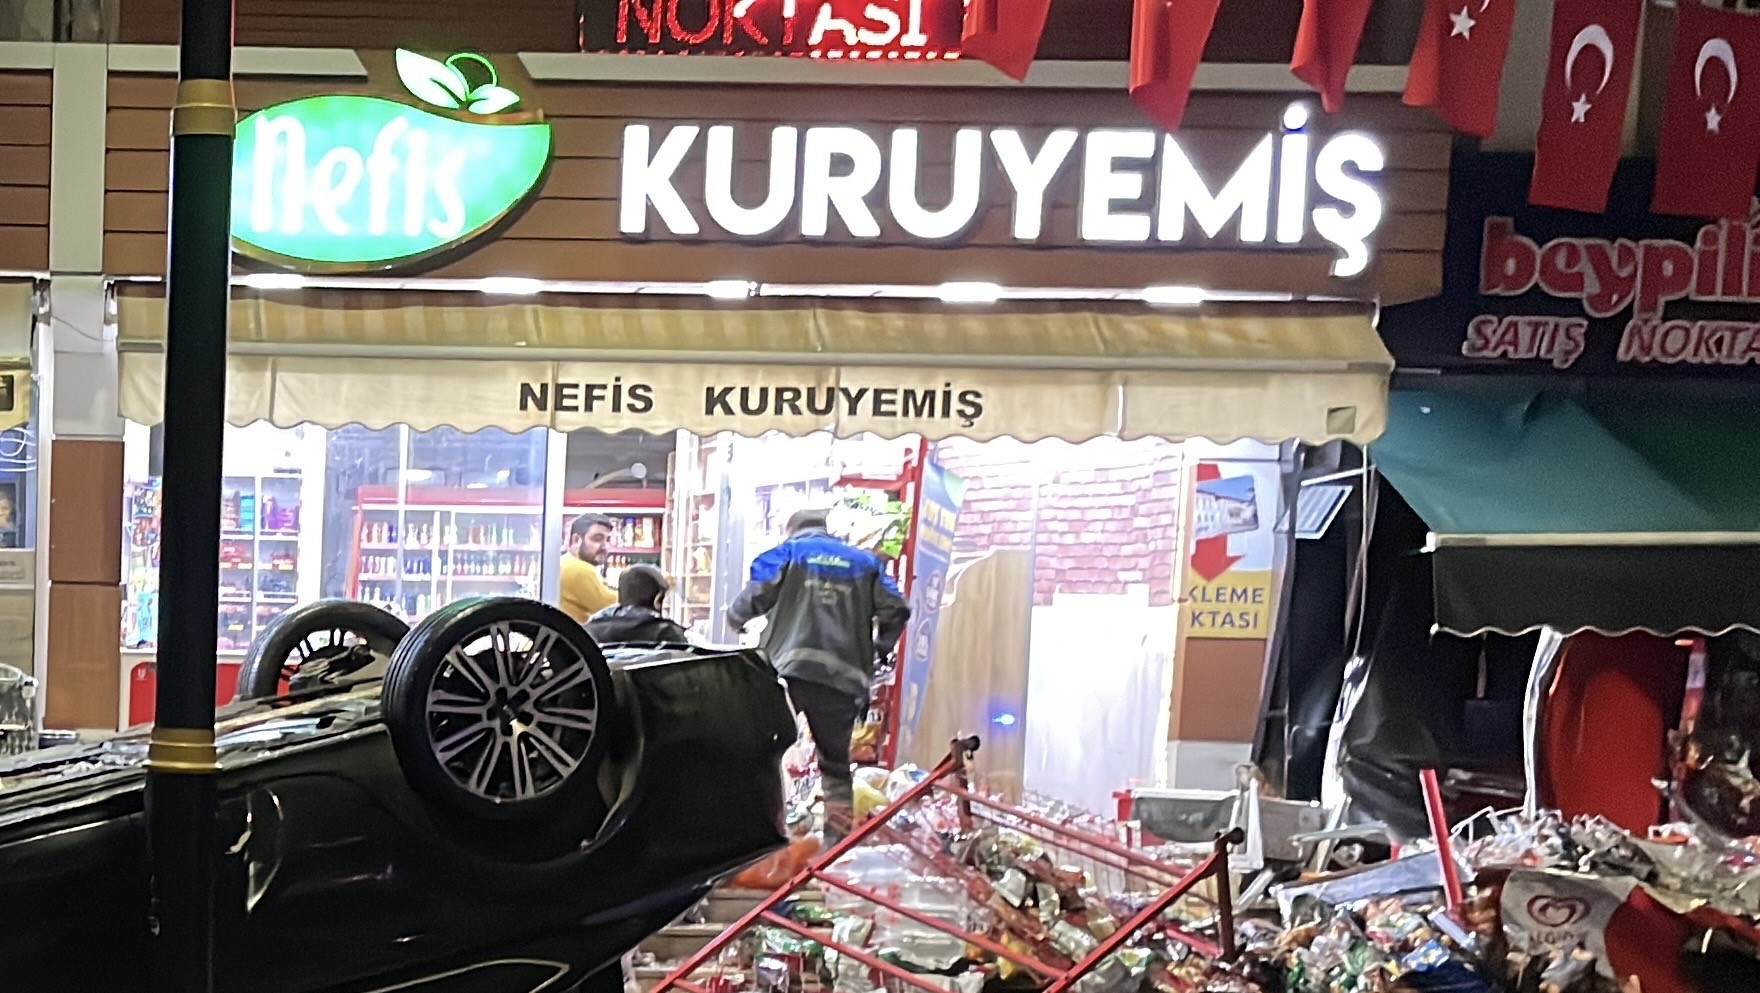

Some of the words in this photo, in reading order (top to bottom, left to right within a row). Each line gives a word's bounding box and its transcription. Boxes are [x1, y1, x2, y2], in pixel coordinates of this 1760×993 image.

[618, 102, 1386, 278] KURUYEMİŞ
[1462, 314, 1588, 369] SATIŞ
[518, 376, 654, 413] NEFİS
[704, 383, 984, 429] KURUYEMİŞ
[1191, 610, 1259, 629] KTASI
